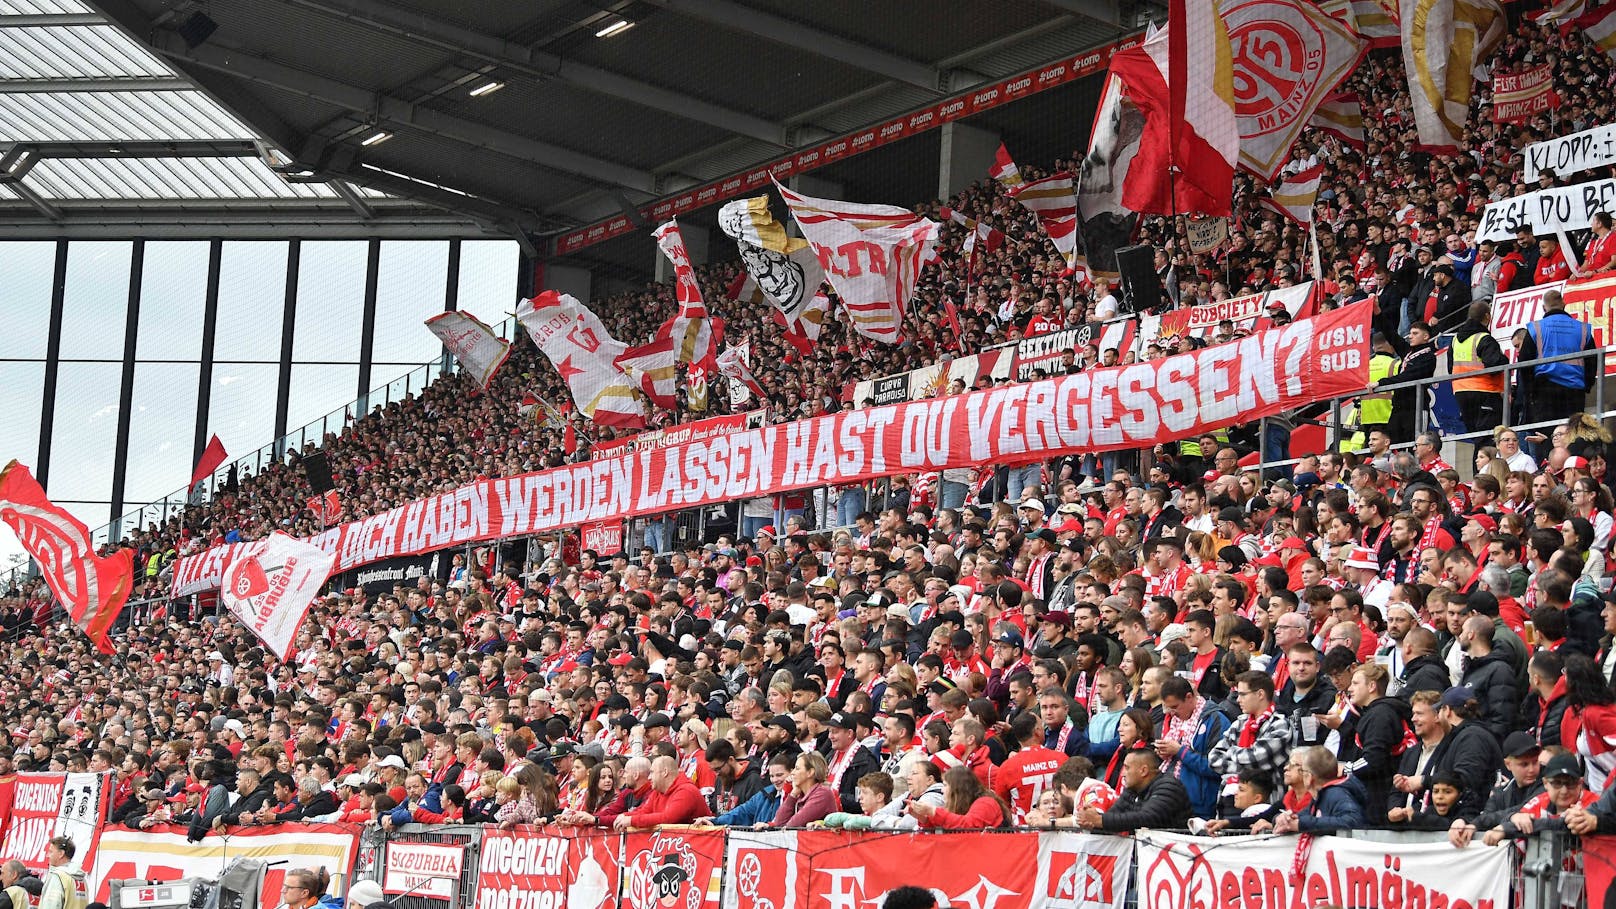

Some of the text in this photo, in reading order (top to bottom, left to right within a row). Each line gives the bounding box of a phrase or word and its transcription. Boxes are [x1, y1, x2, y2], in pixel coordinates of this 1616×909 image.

[1119, 40, 1137, 51] OTTO
[1080, 53, 1100, 67] LOTTO
[1045, 66, 1066, 80] LOTTO
[1012, 78, 1031, 91] LOTTO
[1257, 49, 1321, 131] MAINZ 05
[1494, 76, 1518, 93] FÜR
[980, 90, 998, 102] LOTTO
[946, 101, 964, 113] LOTTO
[1497, 93, 1549, 120] MAINZ 05
[916, 112, 933, 124] LOTTO
[887, 123, 903, 134] LOTTO
[858, 132, 874, 144] LOTTO
[831, 142, 846, 153] LOTTO
[804, 151, 819, 163] LOTTO
[1540, 194, 1571, 226] DU
[1191, 295, 1264, 324] SUBCIETY
[1034, 322, 1048, 332] 20
[1018, 329, 1078, 360] SEKTION
[1319, 324, 1364, 351] USM
[1320, 348, 1361, 374] SUB
[880, 378, 902, 392] CURVA
[874, 388, 906, 404] PARADISO
[170, 544, 230, 598] ALLES
[340, 504, 405, 569] DICH
[401, 482, 489, 552] HABEN
[495, 454, 635, 534] WERDEN
[635, 427, 776, 512] LASSEN
[781, 407, 898, 486] HAST
[900, 397, 965, 468] DU
[965, 317, 1315, 460] VERGESSEN?
[405, 564, 424, 580] Mainz
[1022, 760, 1058, 773] MAINZ 05
[14, 782, 60, 813] EUGENIOS
[6, 815, 55, 863] BANDE
[391, 850, 458, 873] SUBURBIA
[404, 875, 433, 890] MAINZ
